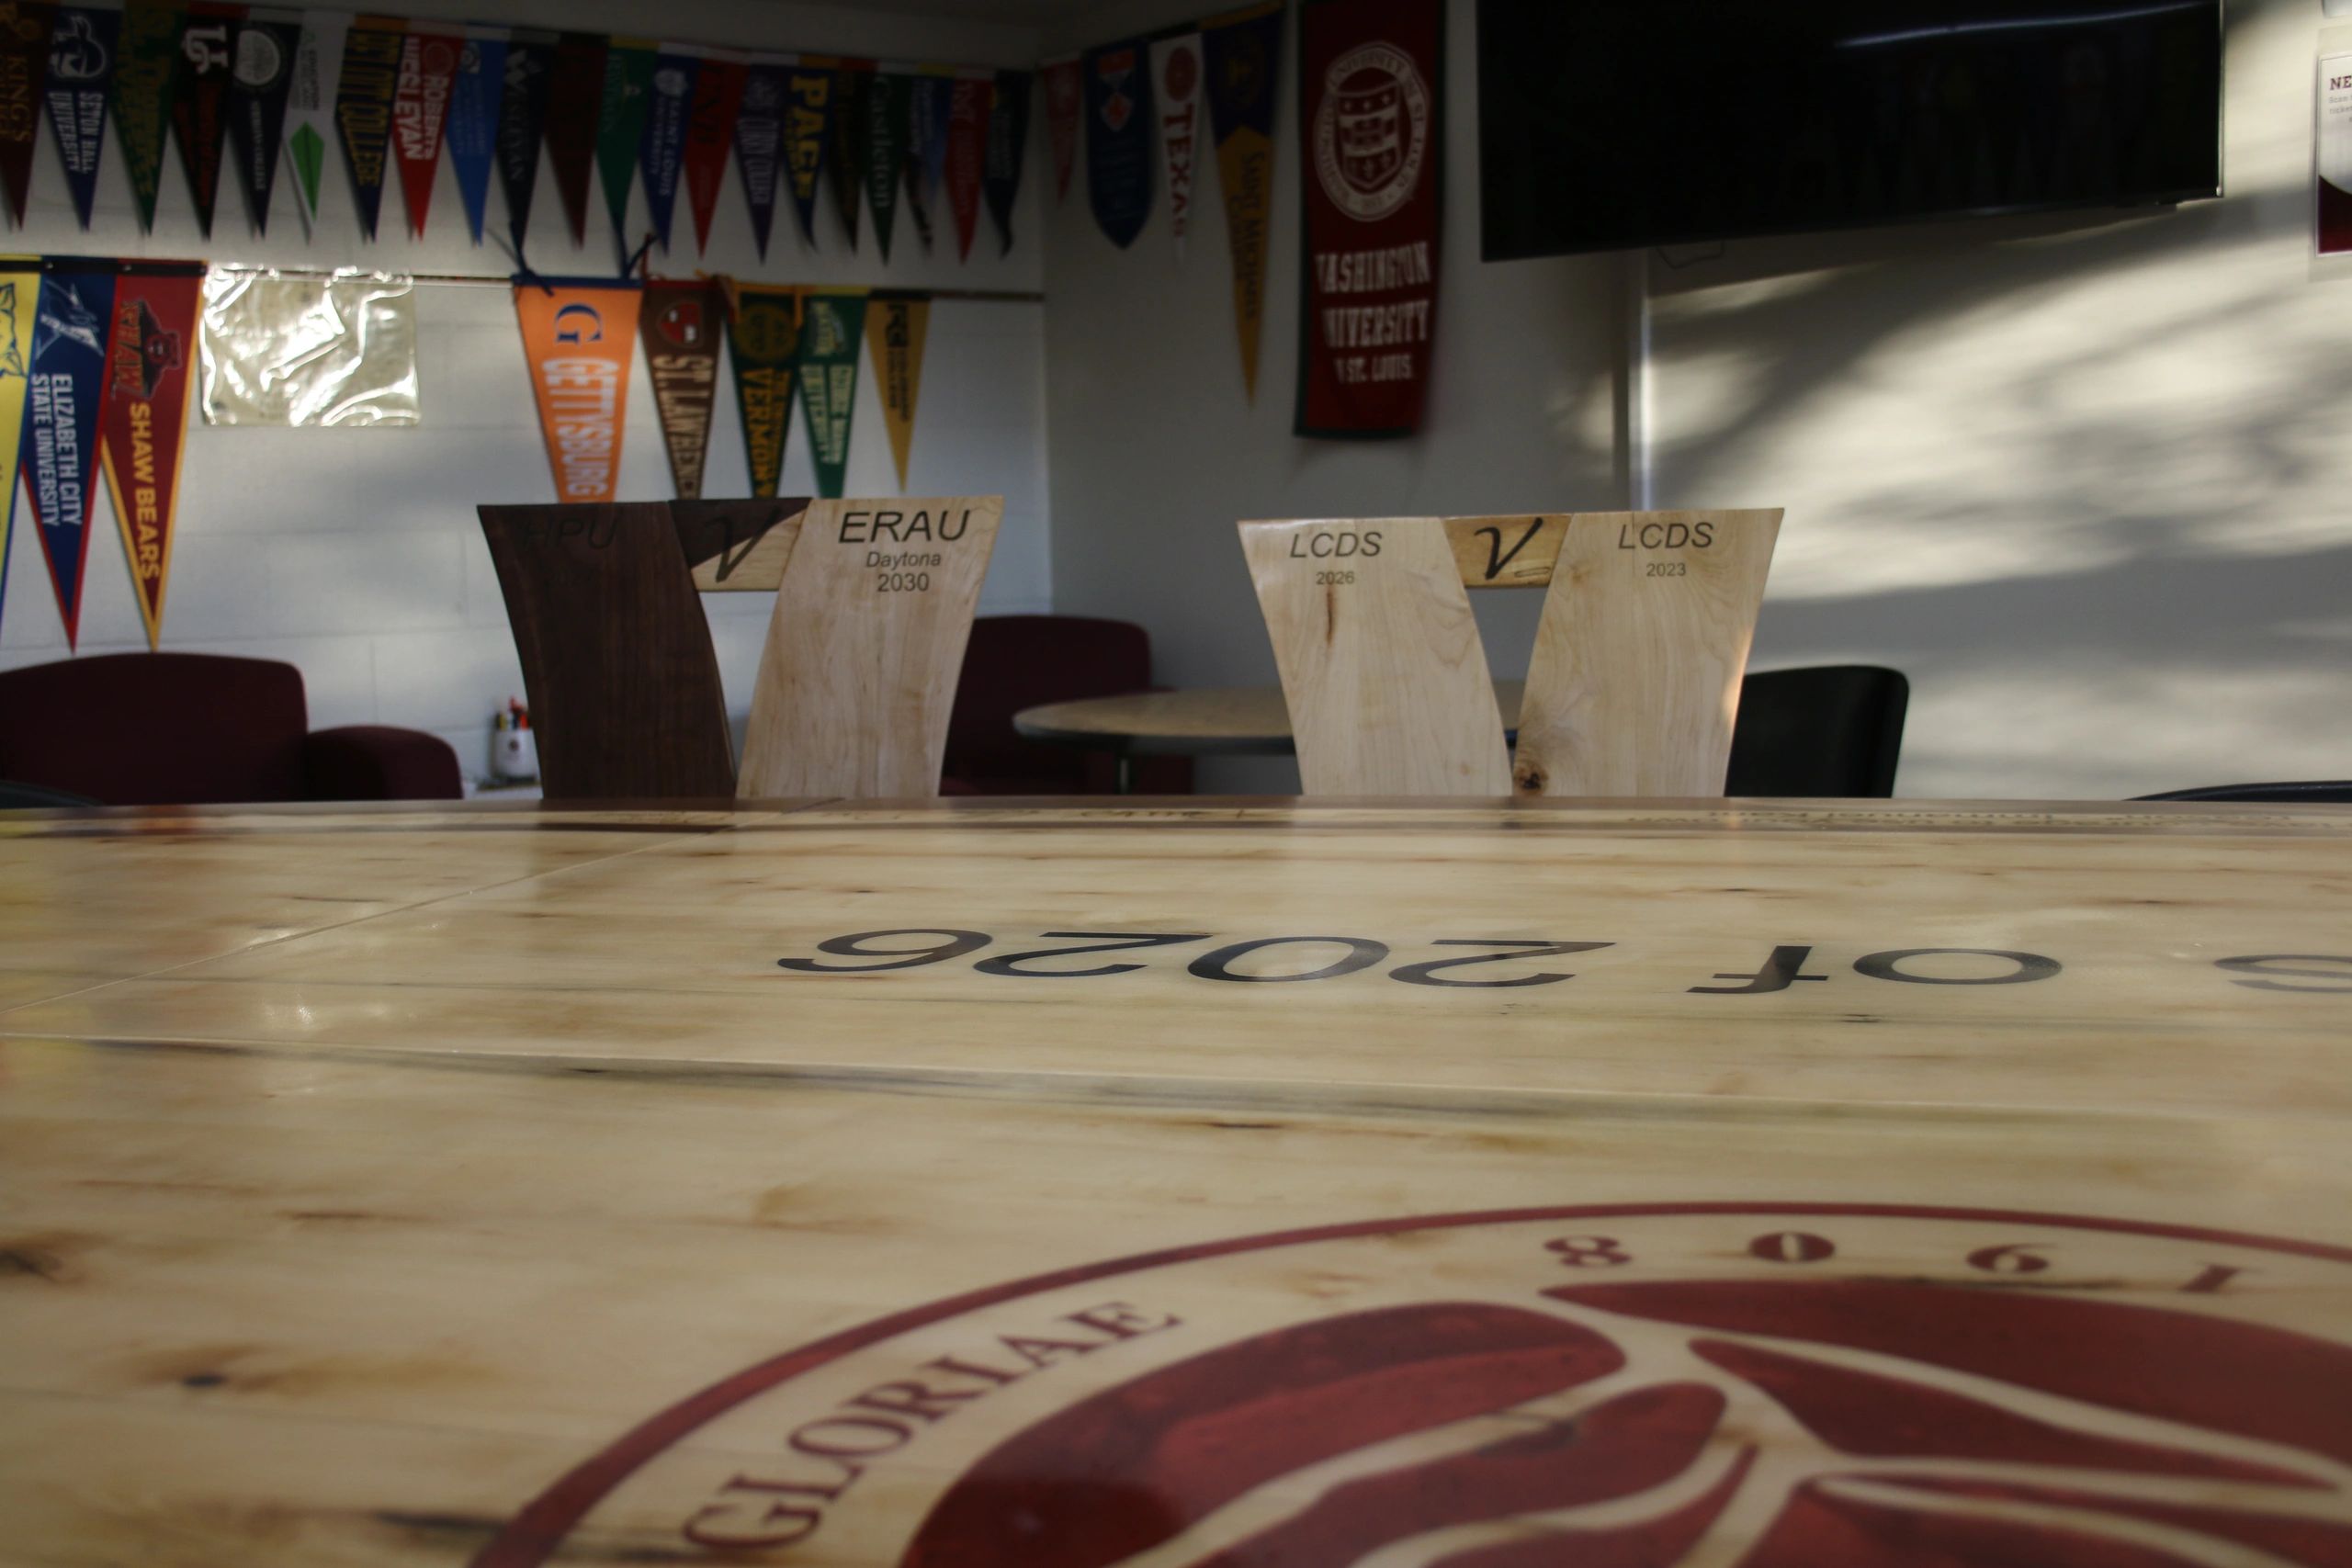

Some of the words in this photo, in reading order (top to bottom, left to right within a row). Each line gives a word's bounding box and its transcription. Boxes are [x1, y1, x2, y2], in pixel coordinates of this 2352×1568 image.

[6, 54, 31, 143] KING'S
[79, 91, 105, 135] SETON
[422, 74, 450, 160] ROBERTS
[48, 91, 80, 172] UNIVERSITY
[872, 75, 893, 209] Castleton
[81, 140, 98, 175] HALL
[657, 149, 677, 197] LOUIS
[555, 303, 604, 345] G
[652, 354, 714, 387] ST.
[30, 373, 53, 424] STATE
[51, 373, 79, 479] ELIZABETH
[129, 402, 154, 482] SHAW
[542, 358, 618, 498] GETTYSBURG
[34, 428, 60, 526] UNIVERSITY
[60, 481, 83, 525] CITY
[838, 510, 970, 543] ERAU
[134, 487, 160, 580] BEARS
[1290, 532, 1383, 558] LCDS
[1619, 522, 1714, 550] LCDS
[865, 550, 942, 570] Daytona
[876, 574, 929, 592] 2030
[1316, 570, 1355, 585] 2026
[1646, 562, 1687, 578] 2023
[777, 929, 1616, 987] 2026
[1685, 945, 2063, 994] of
[682, 1300, 1185, 1551] GLORIAE
